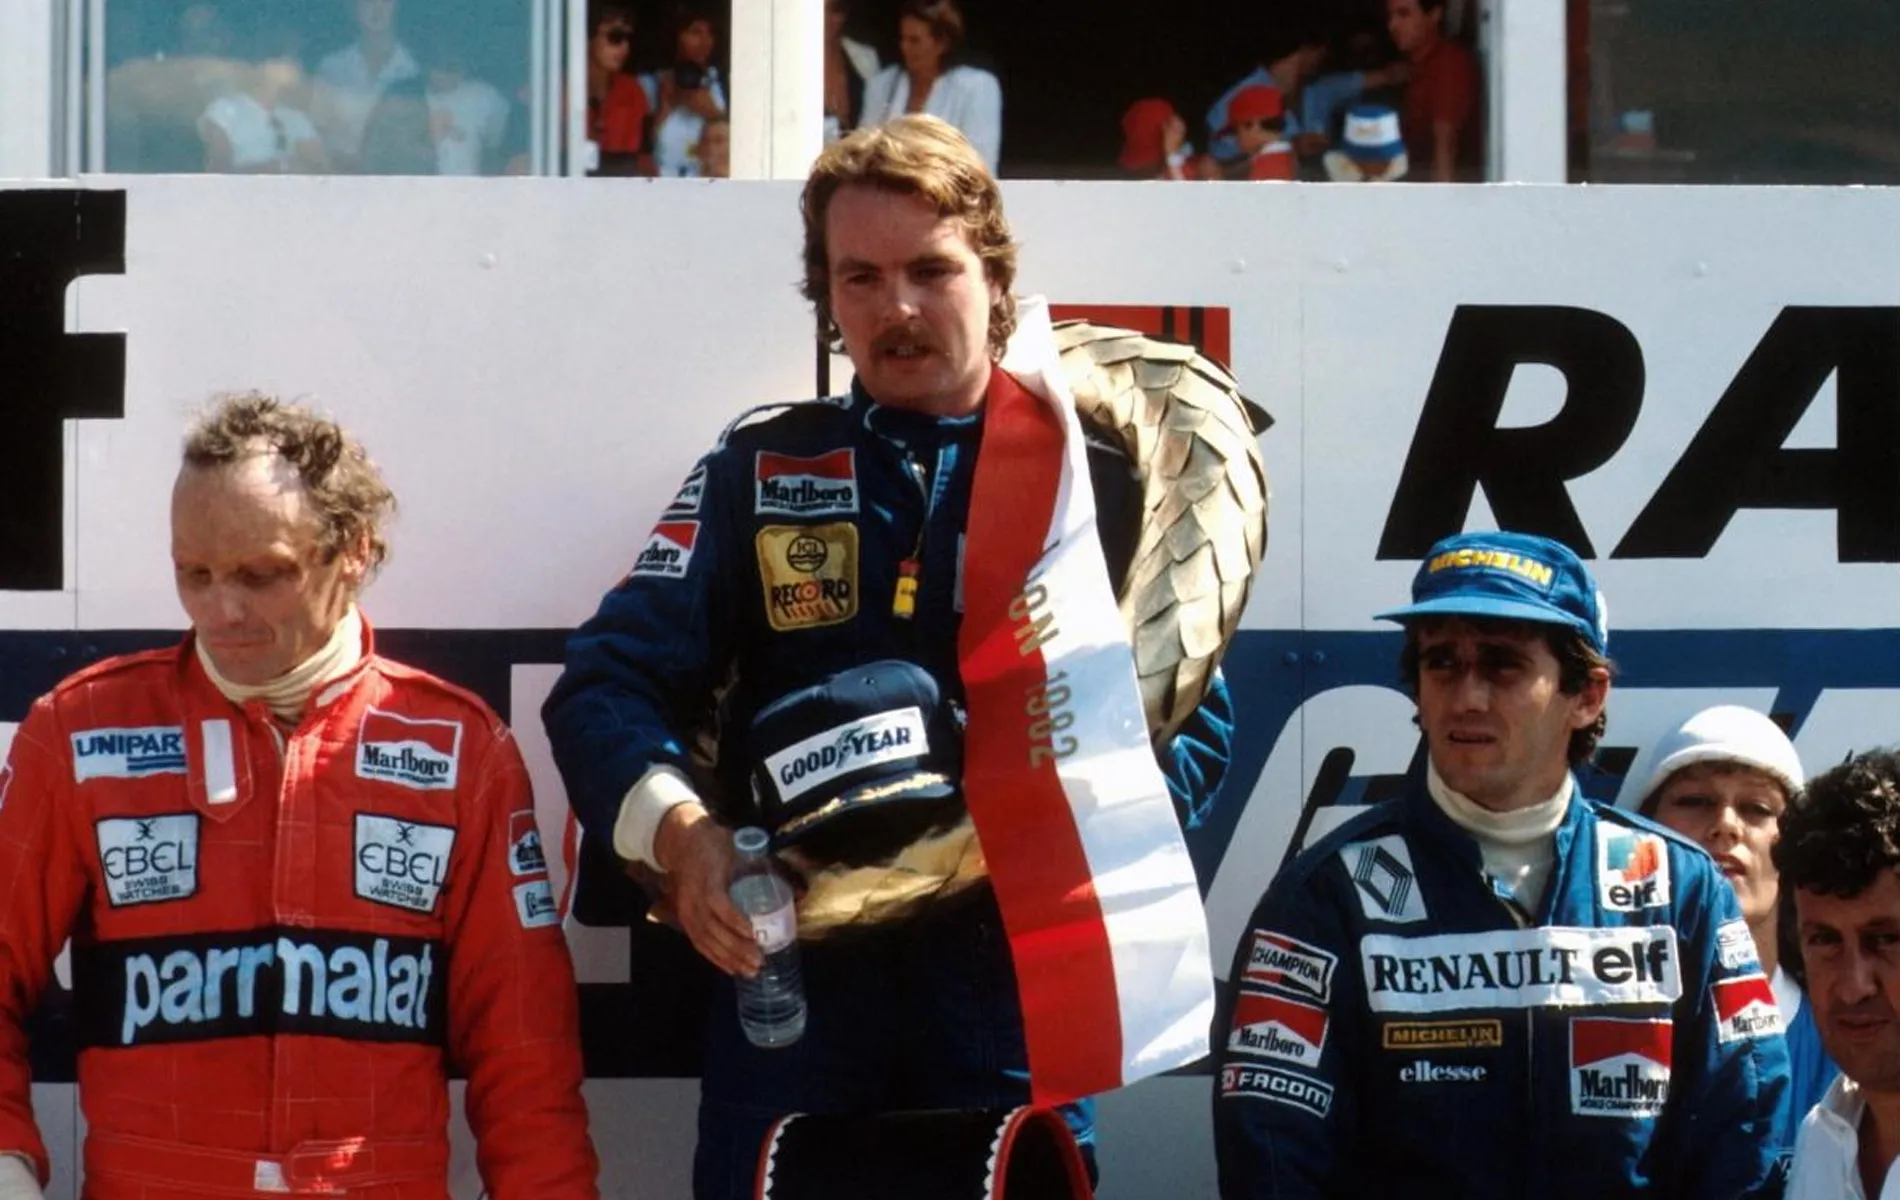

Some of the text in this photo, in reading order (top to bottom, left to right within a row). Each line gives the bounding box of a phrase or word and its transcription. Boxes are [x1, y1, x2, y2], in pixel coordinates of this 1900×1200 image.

[761, 480, 852, 502] Marlboro
[1429, 549, 1553, 585] MICHELIN
[772, 579, 849, 617] RECORD
[76, 733, 183, 757] UNIPAR
[363, 745, 449, 775] Marlboro
[104, 841, 192, 879] EBEL
[359, 843, 442, 887] EBEL
[1609, 881, 1657, 908] elf
[1252, 947, 1320, 982] CHAMPION
[1370, 939, 1668, 994] RENAULT elf
[1239, 1026, 1305, 1058] Marlboro
[1393, 1027, 1494, 1042] MICHELIN
[1400, 1060, 1487, 1082] ellesse
[1238, 1072, 1330, 1109] FACOM
